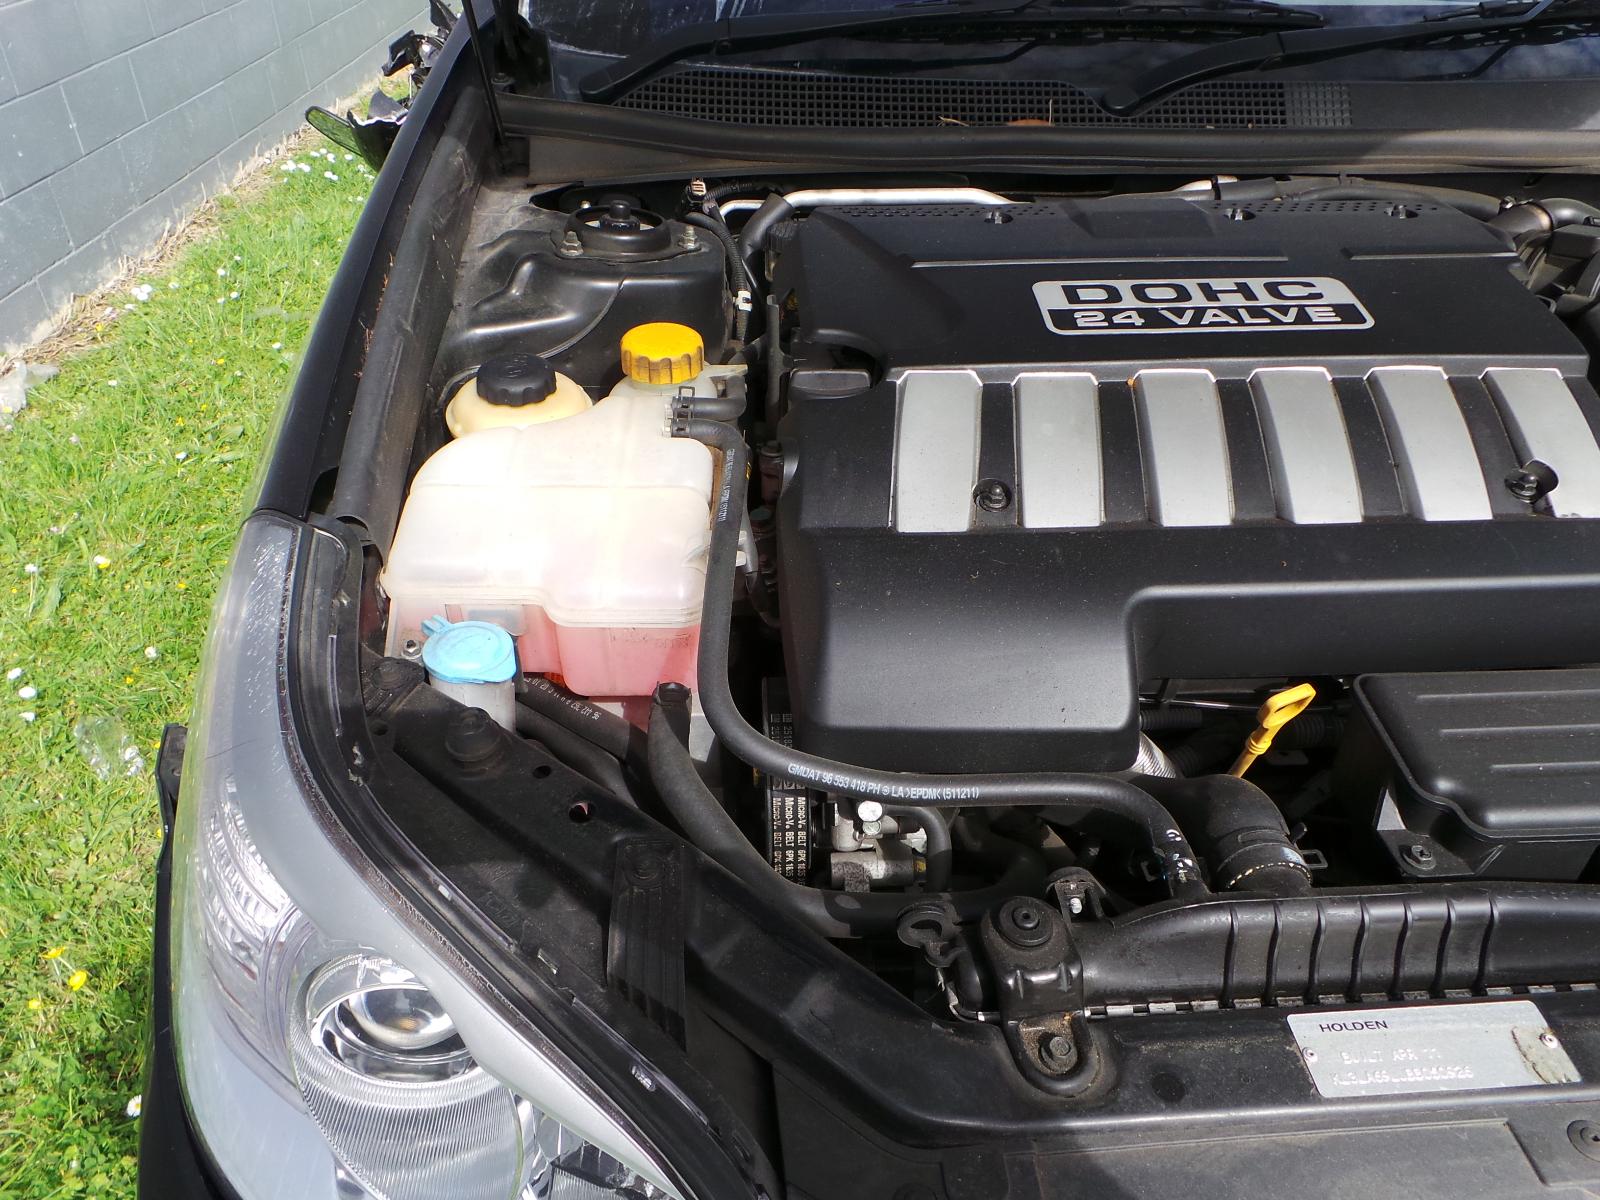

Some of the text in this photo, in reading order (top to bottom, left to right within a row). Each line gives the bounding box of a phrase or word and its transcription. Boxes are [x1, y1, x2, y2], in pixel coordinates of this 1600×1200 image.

[1061, 281, 1324, 305] DOHC
[1073, 306, 1342, 327] 24 VALVE
[787, 763, 821, 781] GMDAT
[821, 772, 833, 785] 96
[833, 774, 850, 789] 553
[850, 779, 866, 793] 418
[773, 831, 782, 847] BELT
[785, 831, 794, 847] BELT
[797, 831, 806, 847] BELT
[785, 850, 794, 862] 6PK
[797, 850, 806, 862] 6PK
[1319, 1020, 1388, 1033] HOLDEN
